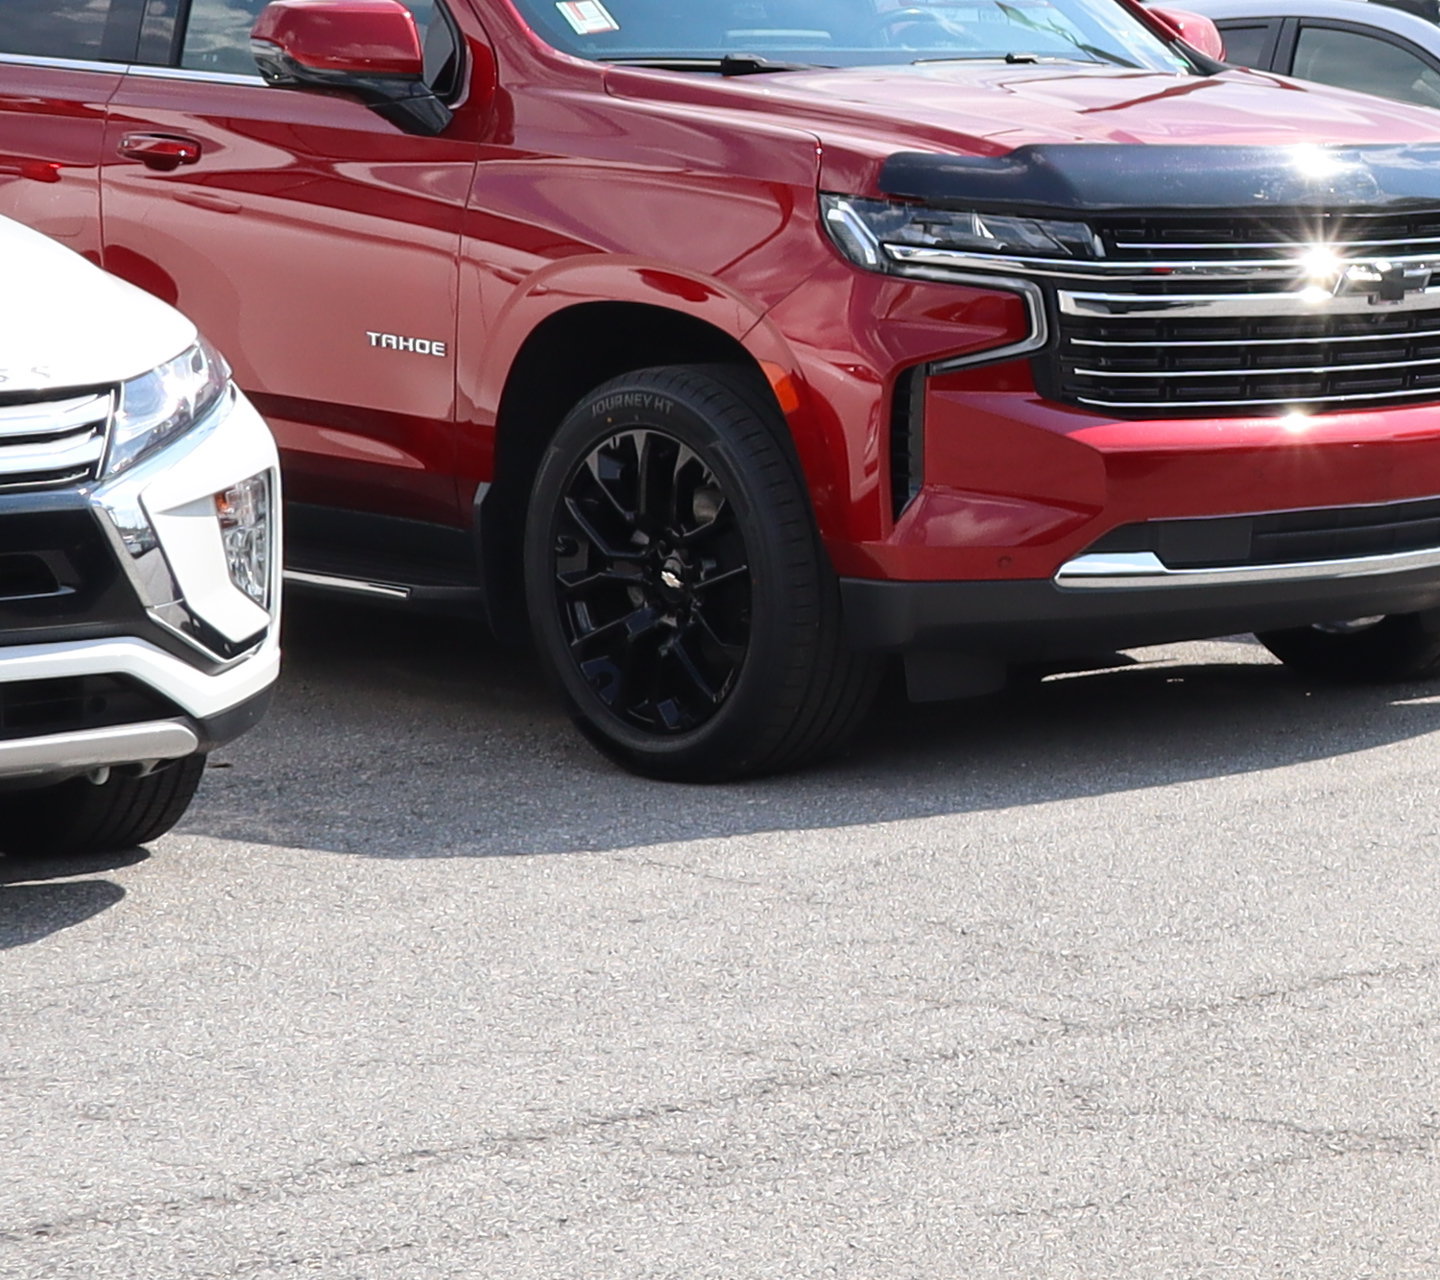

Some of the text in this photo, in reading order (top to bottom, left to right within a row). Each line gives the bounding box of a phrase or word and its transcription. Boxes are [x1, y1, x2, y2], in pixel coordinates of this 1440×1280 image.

[367, 331, 447, 356] TAHOE
[592, 393, 674, 416] JOURNEY HT
